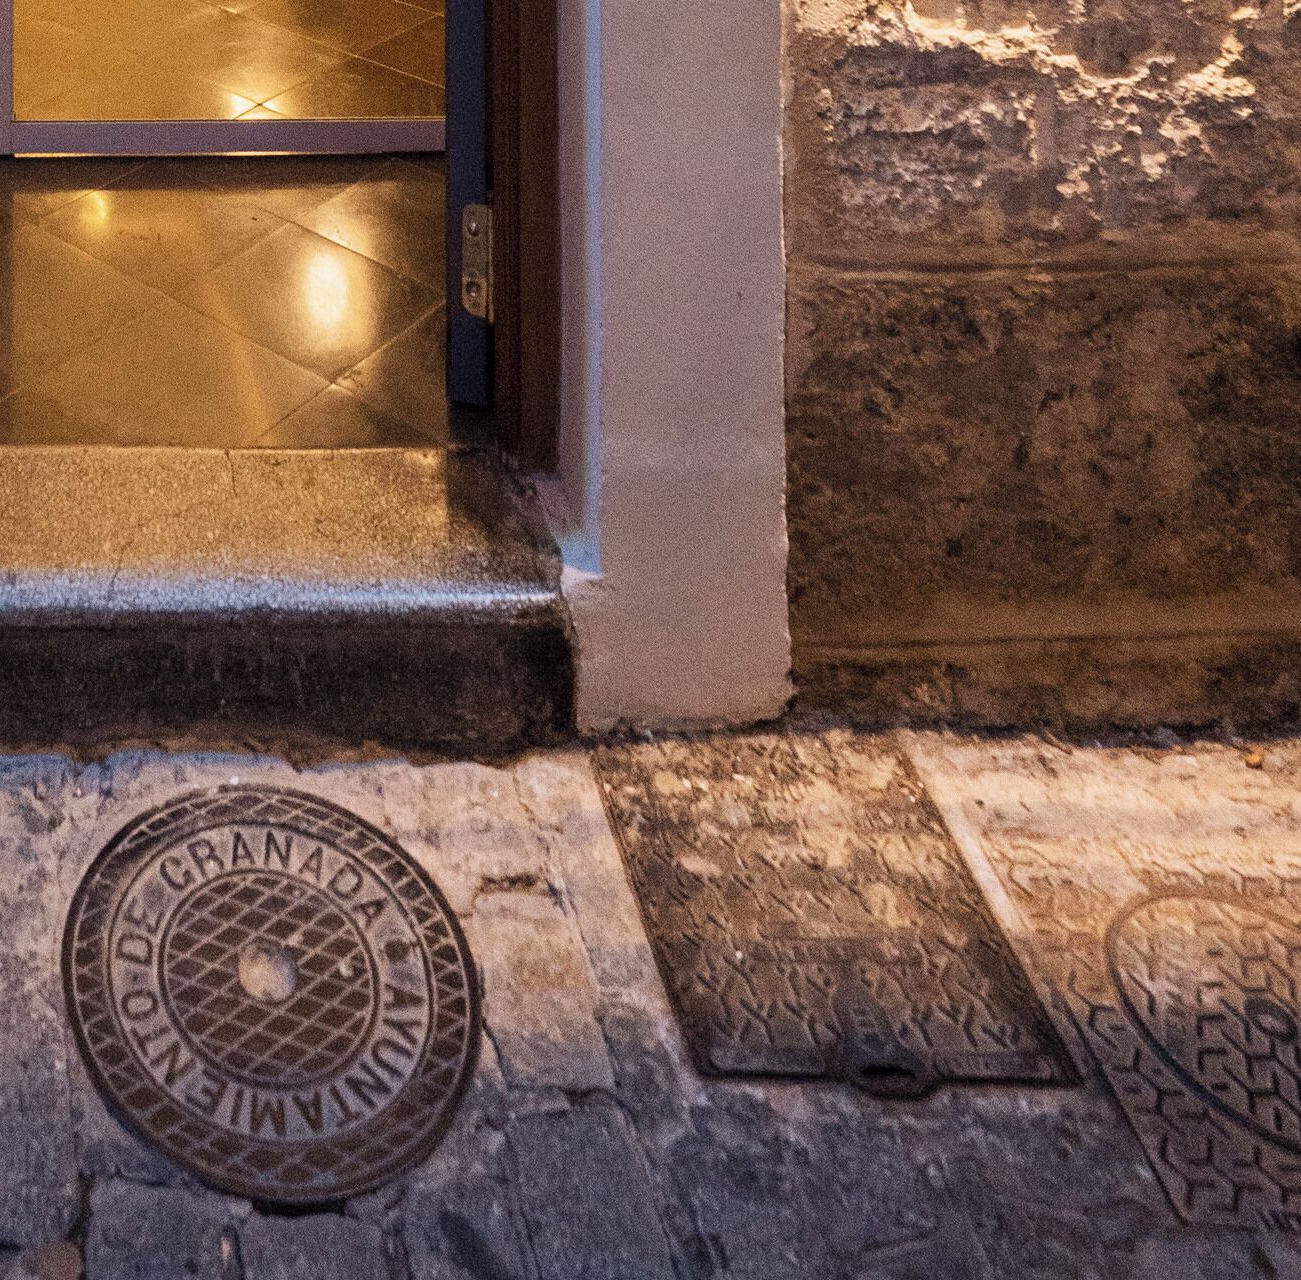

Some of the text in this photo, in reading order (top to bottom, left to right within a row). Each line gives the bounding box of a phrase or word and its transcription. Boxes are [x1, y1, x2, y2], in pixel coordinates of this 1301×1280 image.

[116, 831, 423, 1136] AYUNTAMIENTO DE GRANADA
